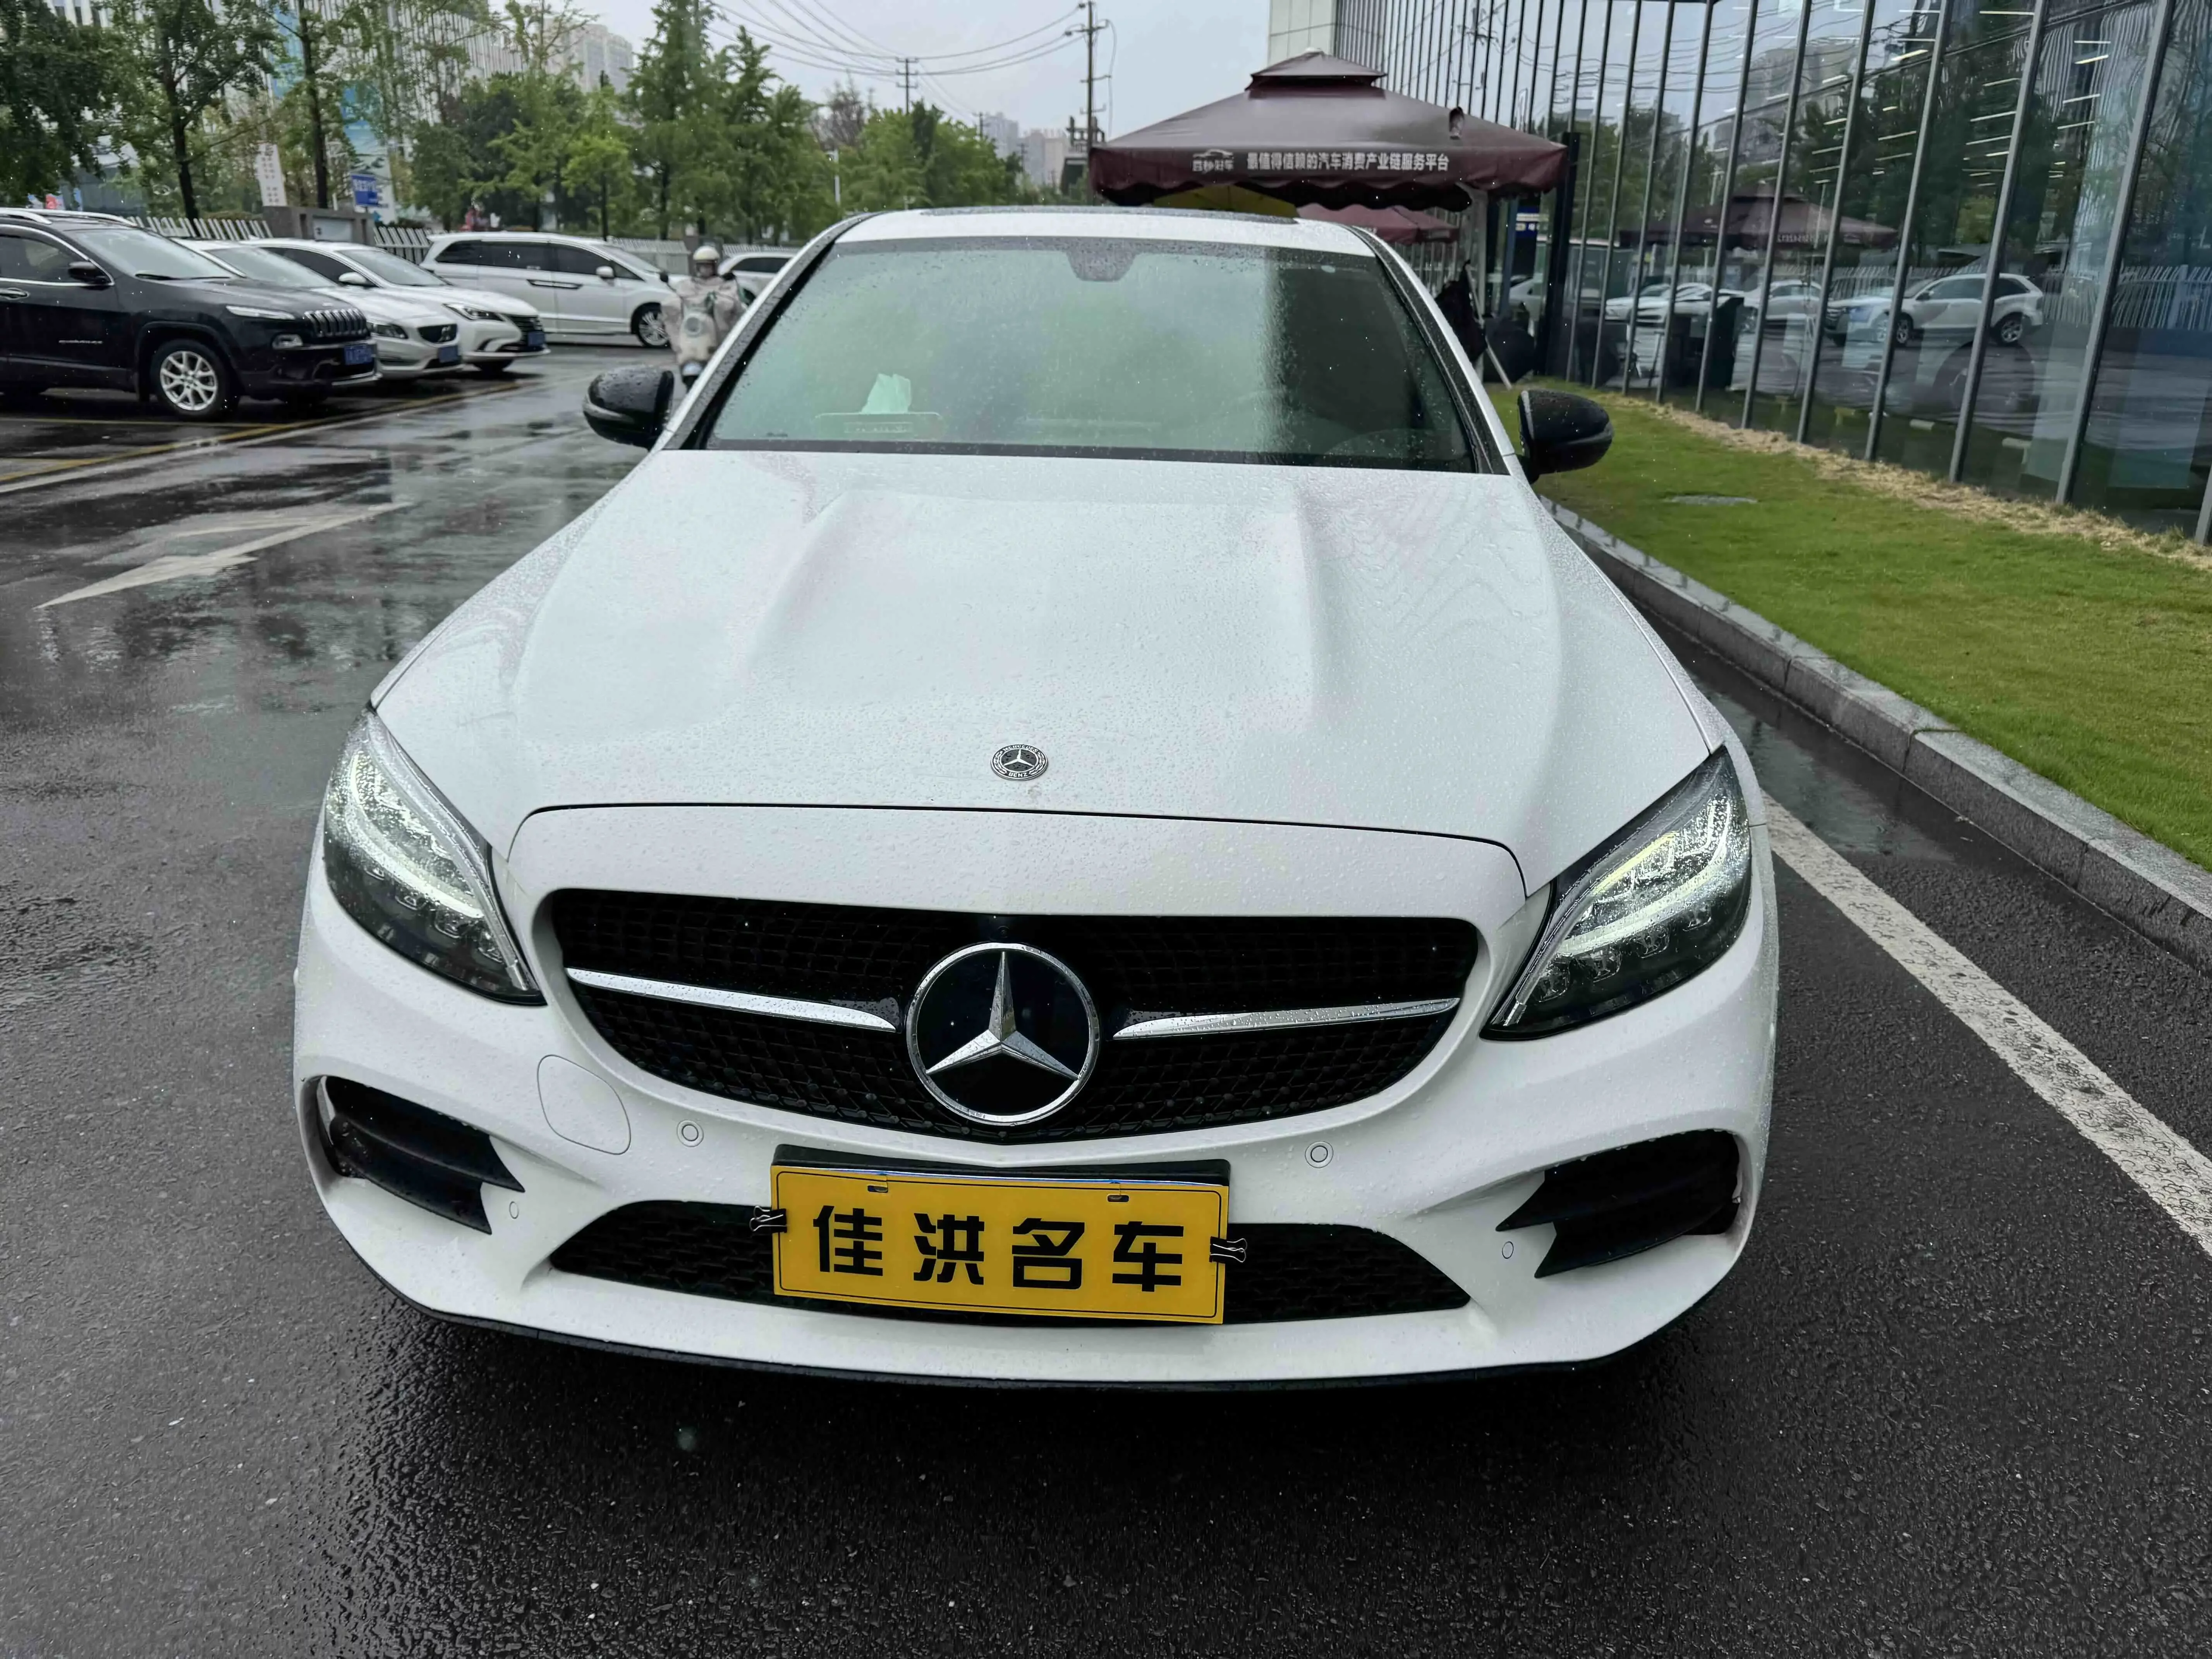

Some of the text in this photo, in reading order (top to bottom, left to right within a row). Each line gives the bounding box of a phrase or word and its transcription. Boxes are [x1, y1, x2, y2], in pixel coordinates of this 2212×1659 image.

[1247, 152, 1449, 171] 最值得信赖的汽车消费产业链服务平台
[813, 1205, 1184, 1292] 佳洪名车
